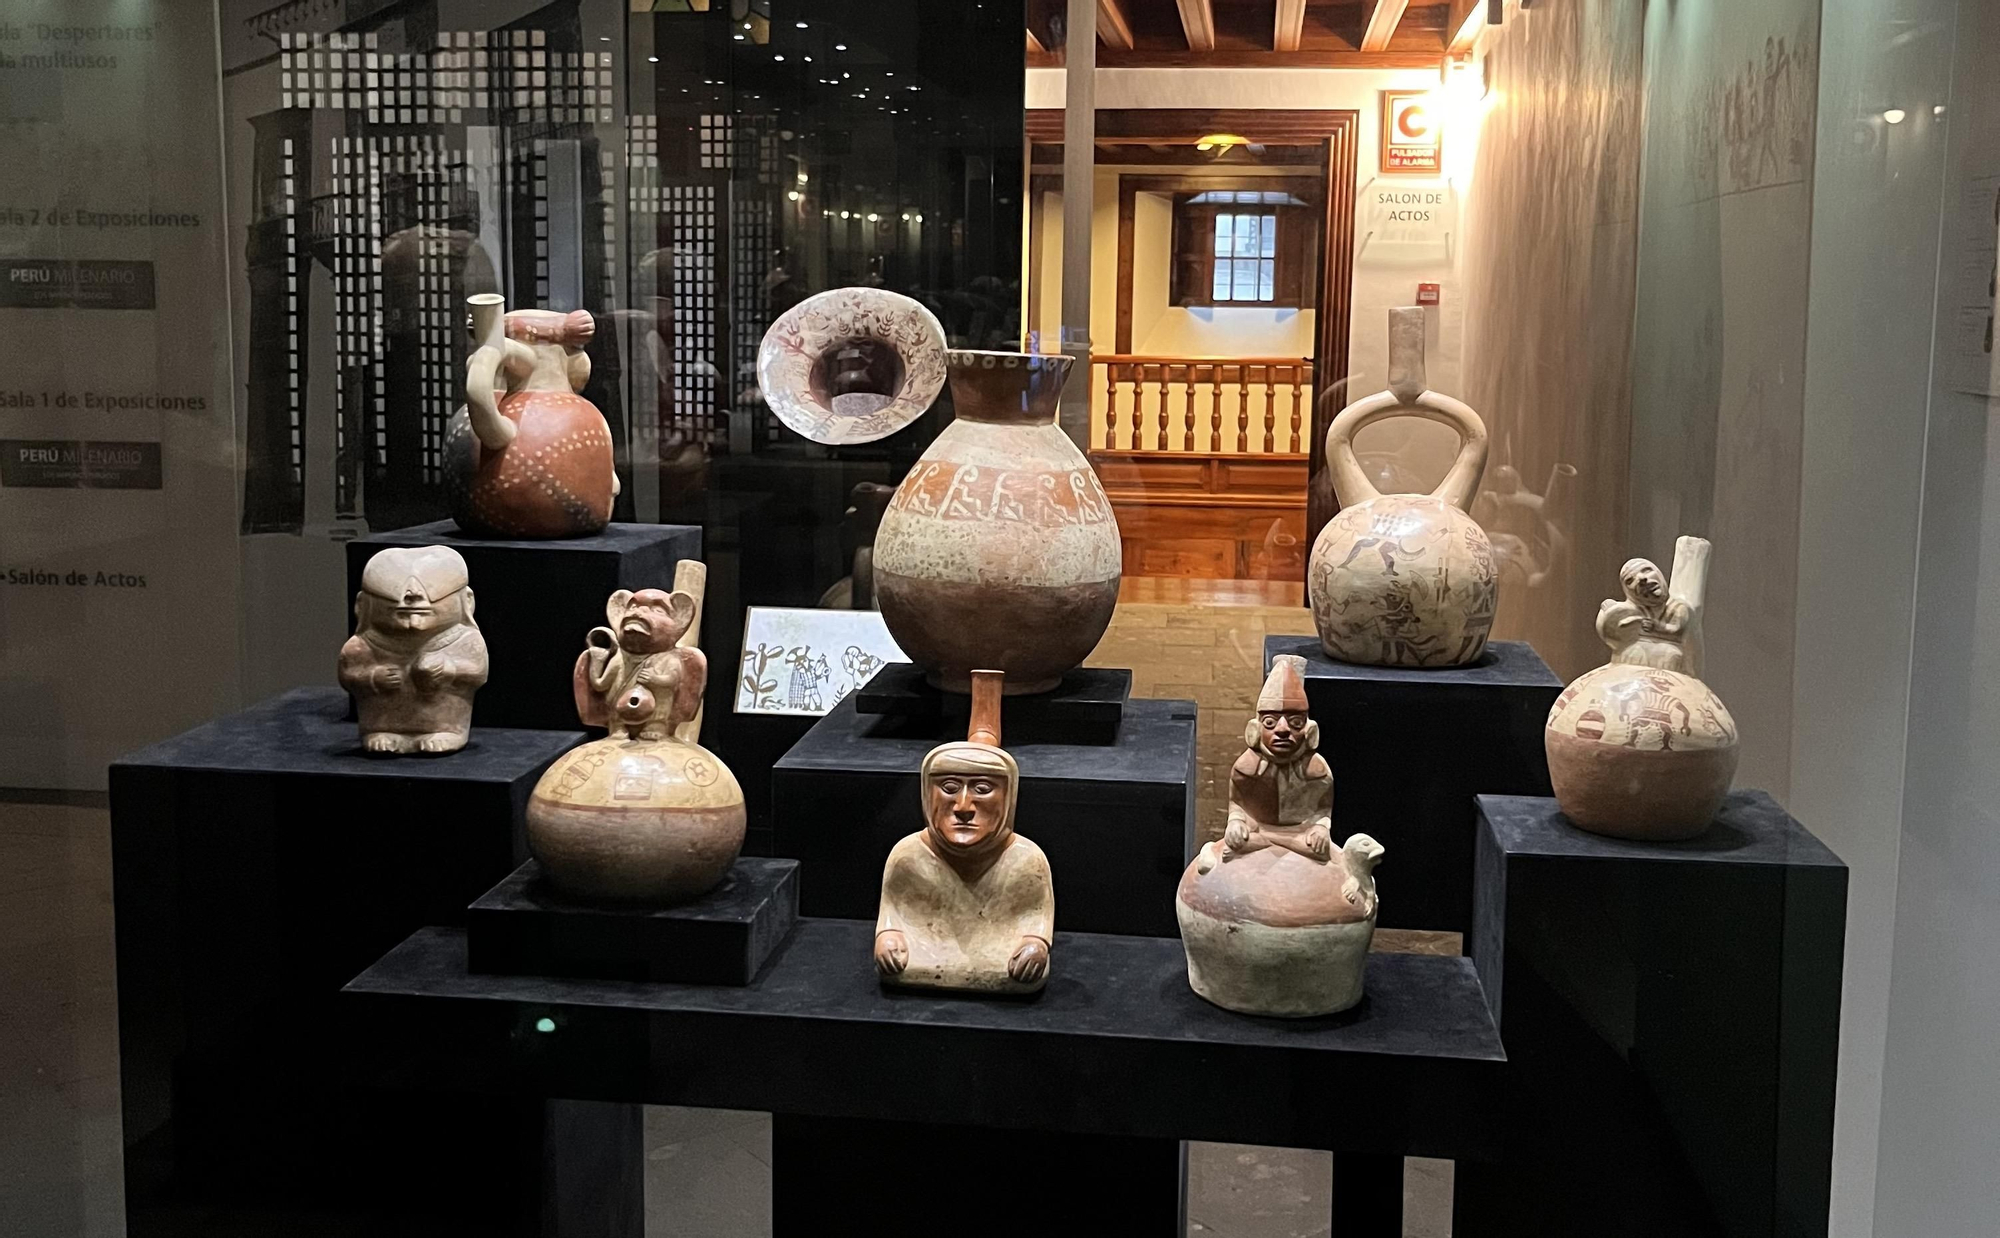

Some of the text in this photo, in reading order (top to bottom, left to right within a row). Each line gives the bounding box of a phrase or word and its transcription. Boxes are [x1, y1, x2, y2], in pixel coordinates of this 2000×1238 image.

[22, 51, 117, 69] multiusos
[1390, 158, 1400, 166] DE
[1378, 193, 1442, 204] SALON DE
[29, 209, 40, 226] 2
[46, 208, 70, 227] de
[76, 209, 201, 231] Exposiciones
[1388, 210, 1430, 221] ACTOS
[41, 392, 49, 407] 1
[55, 392, 79, 409] de
[84, 392, 206, 412] Exposiciones
[9, 568, 147, 588] Salón de Actos
